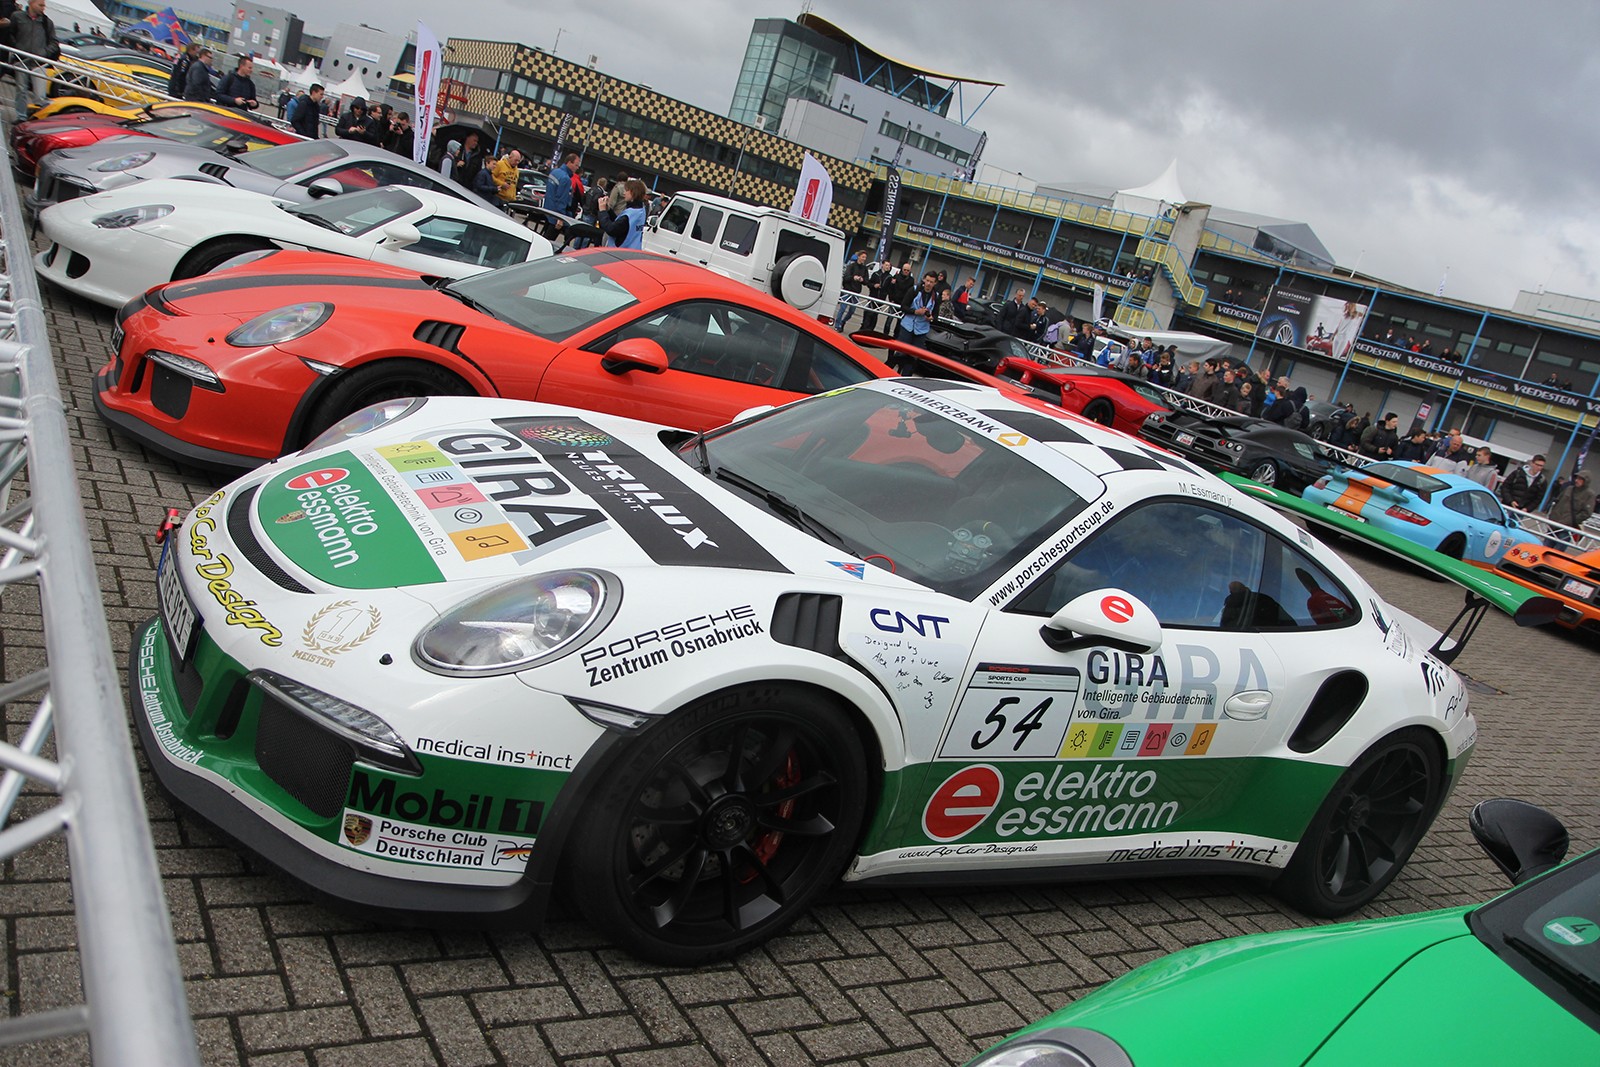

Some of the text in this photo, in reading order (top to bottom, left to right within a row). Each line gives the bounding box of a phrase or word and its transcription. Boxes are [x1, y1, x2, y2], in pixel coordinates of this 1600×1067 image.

[1217, 305, 1260, 322] VREDESTEIN
[1355, 342, 1402, 360] REDESTEIN
[1407, 355, 1464, 377] VREDESTEIN
[1513, 383, 1579, 407] VREDESTEIN
[891, 386, 1000, 434] COMMERZBANK
[565, 452, 606, 481] NEUES
[438, 433, 608, 547] GIRA
[326, 484, 379, 536] elektro
[297, 490, 360, 569] essmann
[428, 536, 448, 557] Gira
[988, 499, 1115, 608] www.porschesportscup.de
[196, 553, 283, 648] Design
[580, 604, 757, 667] PORSCHE
[869, 608, 950, 639] CNT
[291, 649, 336, 669] MEISTER
[585, 619, 765, 688] Zentrum Osnabrück
[1087, 650, 1169, 688] GIRA
[1077, 707, 1121, 720] von Gira.
[1081, 689, 1214, 707] Intelligente Gebäudetechnik
[155, 721, 205, 765] Osnabrück
[970, 696, 1054, 752] 54
[416, 737, 492, 761] medical
[348, 770, 494, 830] Mobil
[1013, 764, 1157, 802] elektro
[380, 820, 488, 848] Porsche Club
[995, 800, 1179, 837] essmann
[375, 839, 485, 867] Deutschland
[1106, 839, 1190, 863] medical
